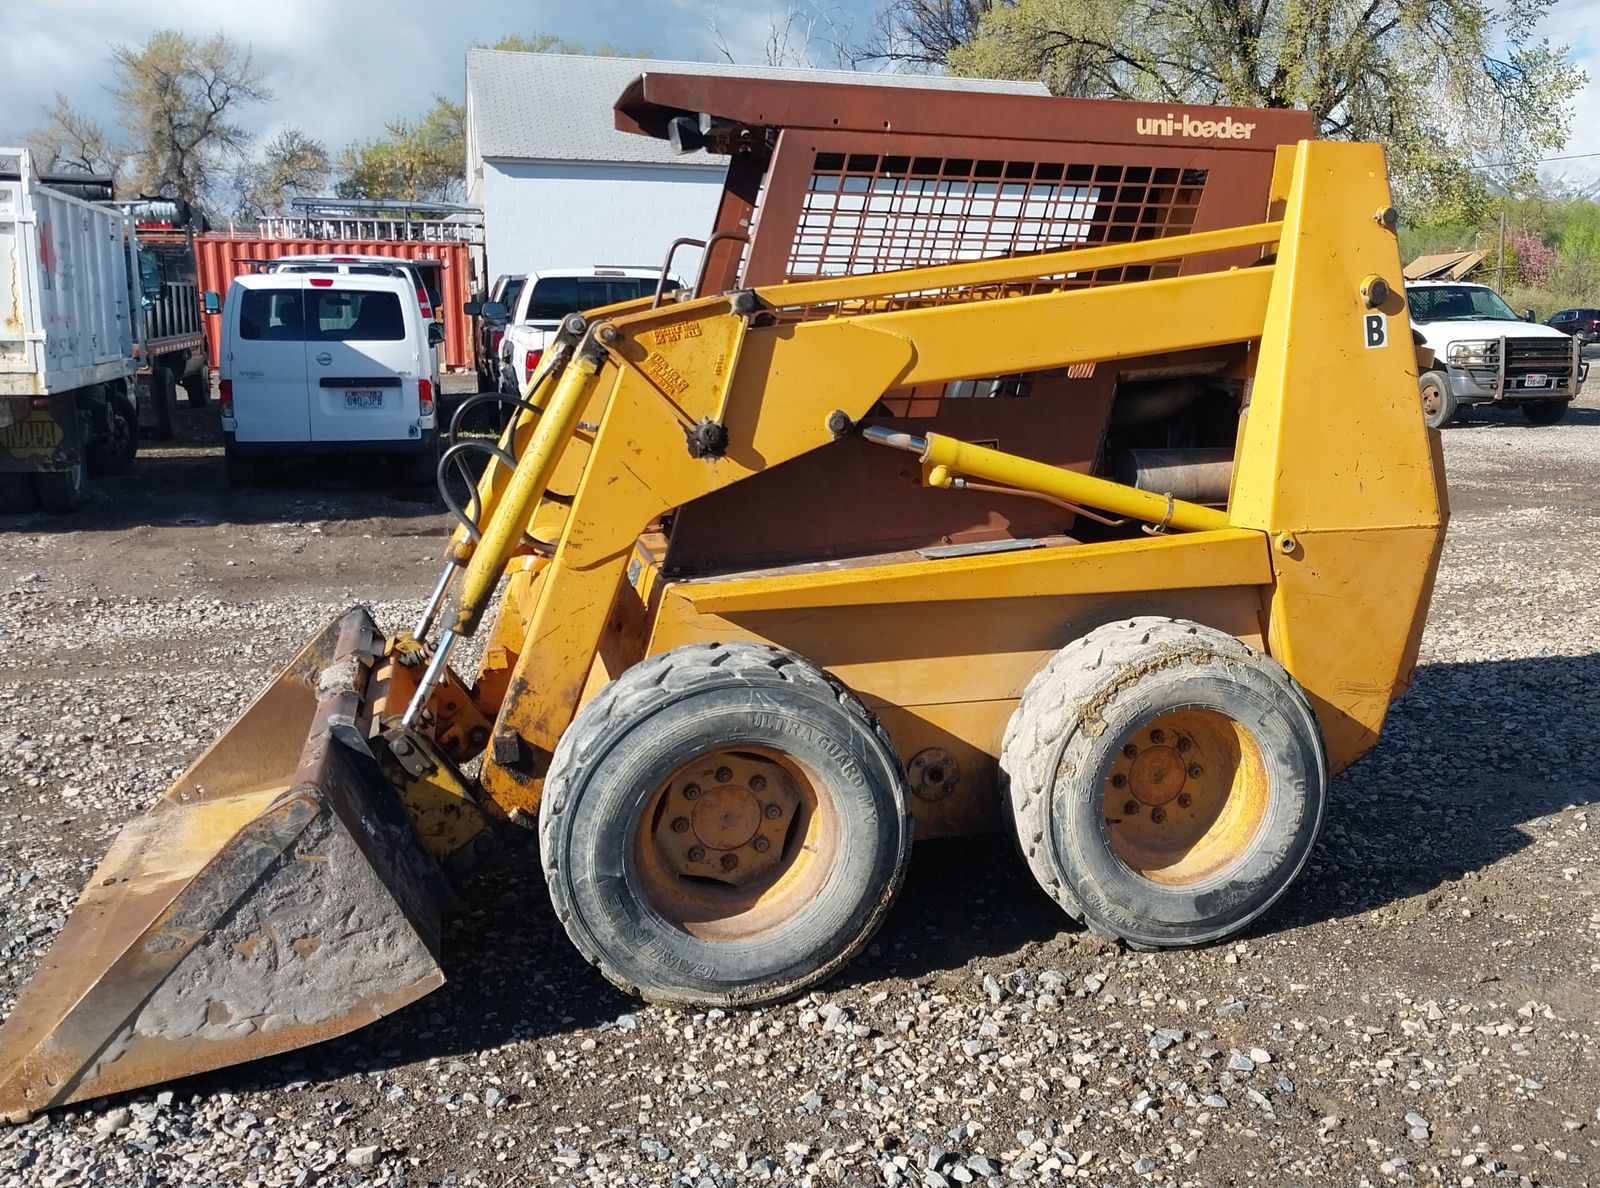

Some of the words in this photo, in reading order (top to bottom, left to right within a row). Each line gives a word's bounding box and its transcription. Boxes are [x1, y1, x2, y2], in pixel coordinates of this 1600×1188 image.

[1136, 113, 1256, 140] uni-loader
[1366, 315, 1385, 347] B
[8, 421, 56, 448] NAPA
[750, 713, 814, 742] ULTRA
[817, 735, 866, 789] GUARD
[858, 793, 878, 826] MX
[606, 892, 717, 979] CARLISLE
